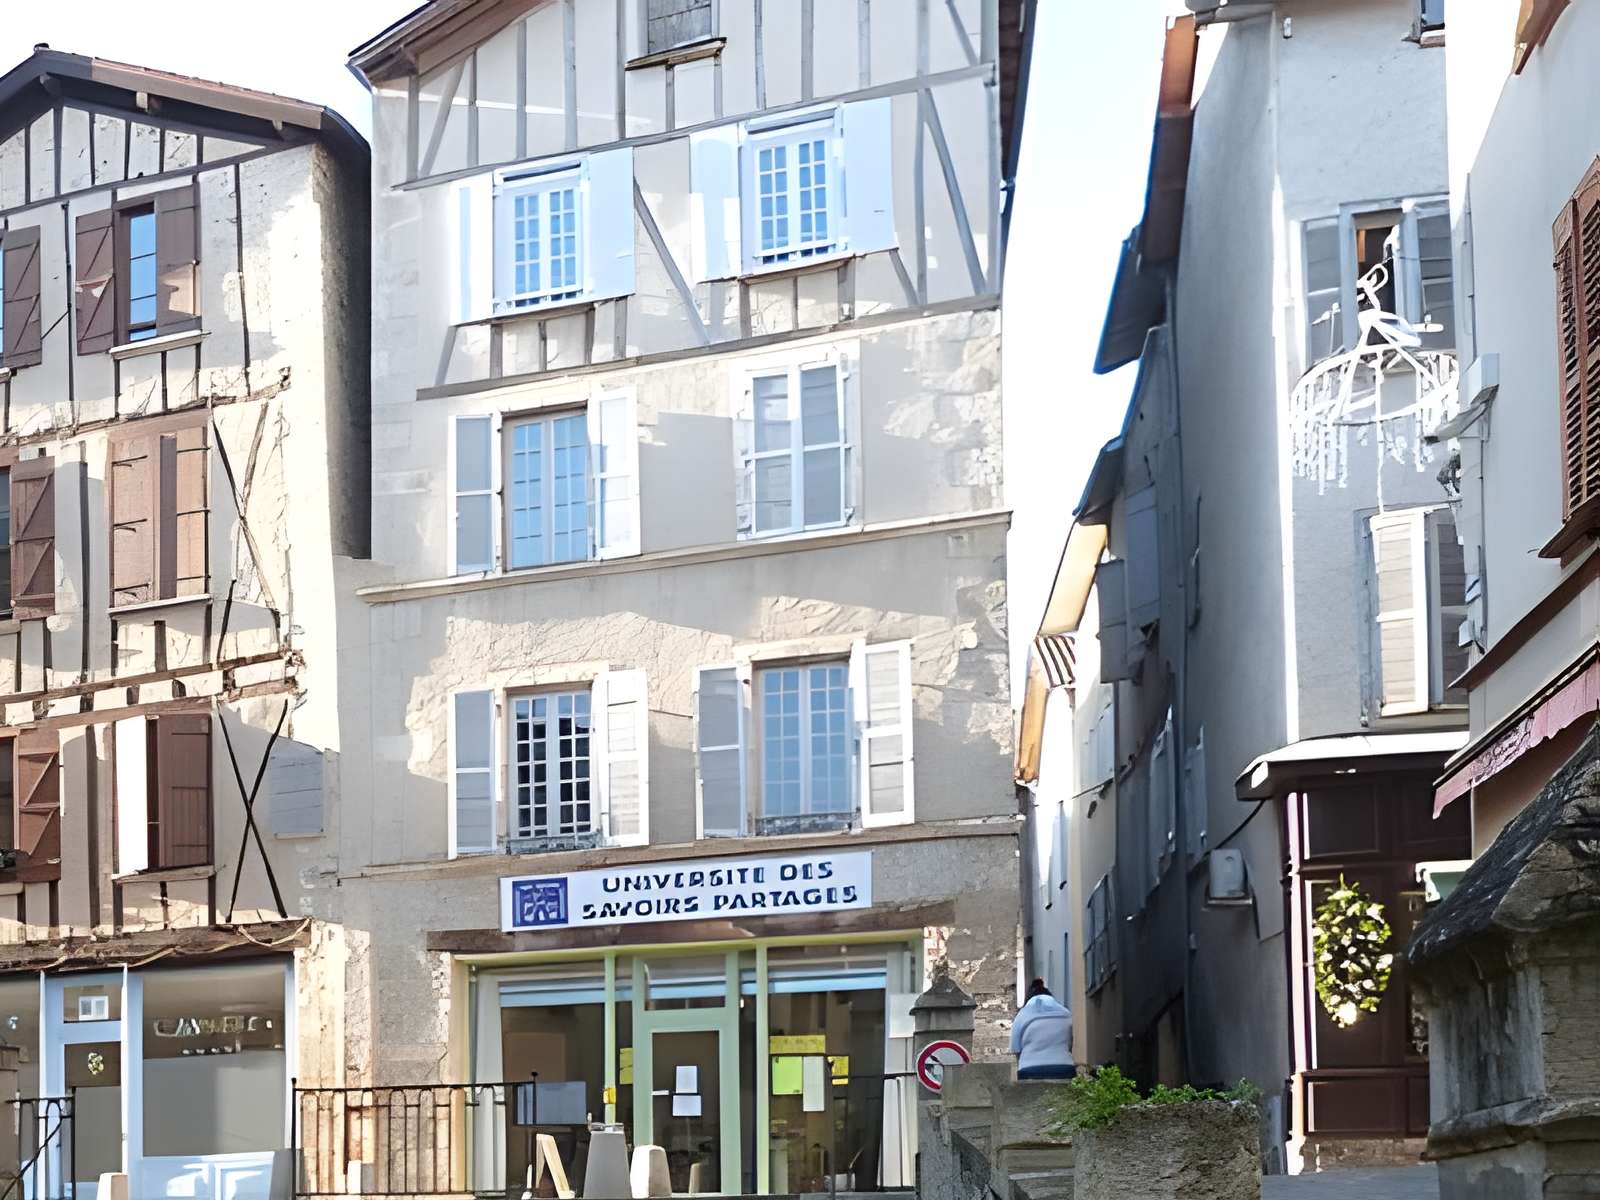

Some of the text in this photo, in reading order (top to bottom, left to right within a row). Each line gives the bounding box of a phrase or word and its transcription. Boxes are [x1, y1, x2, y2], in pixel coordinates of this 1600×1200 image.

[602, 861, 834, 893] UNIVERSITE DES
[582, 885, 858, 919] SAVOIRS PARTAGES
